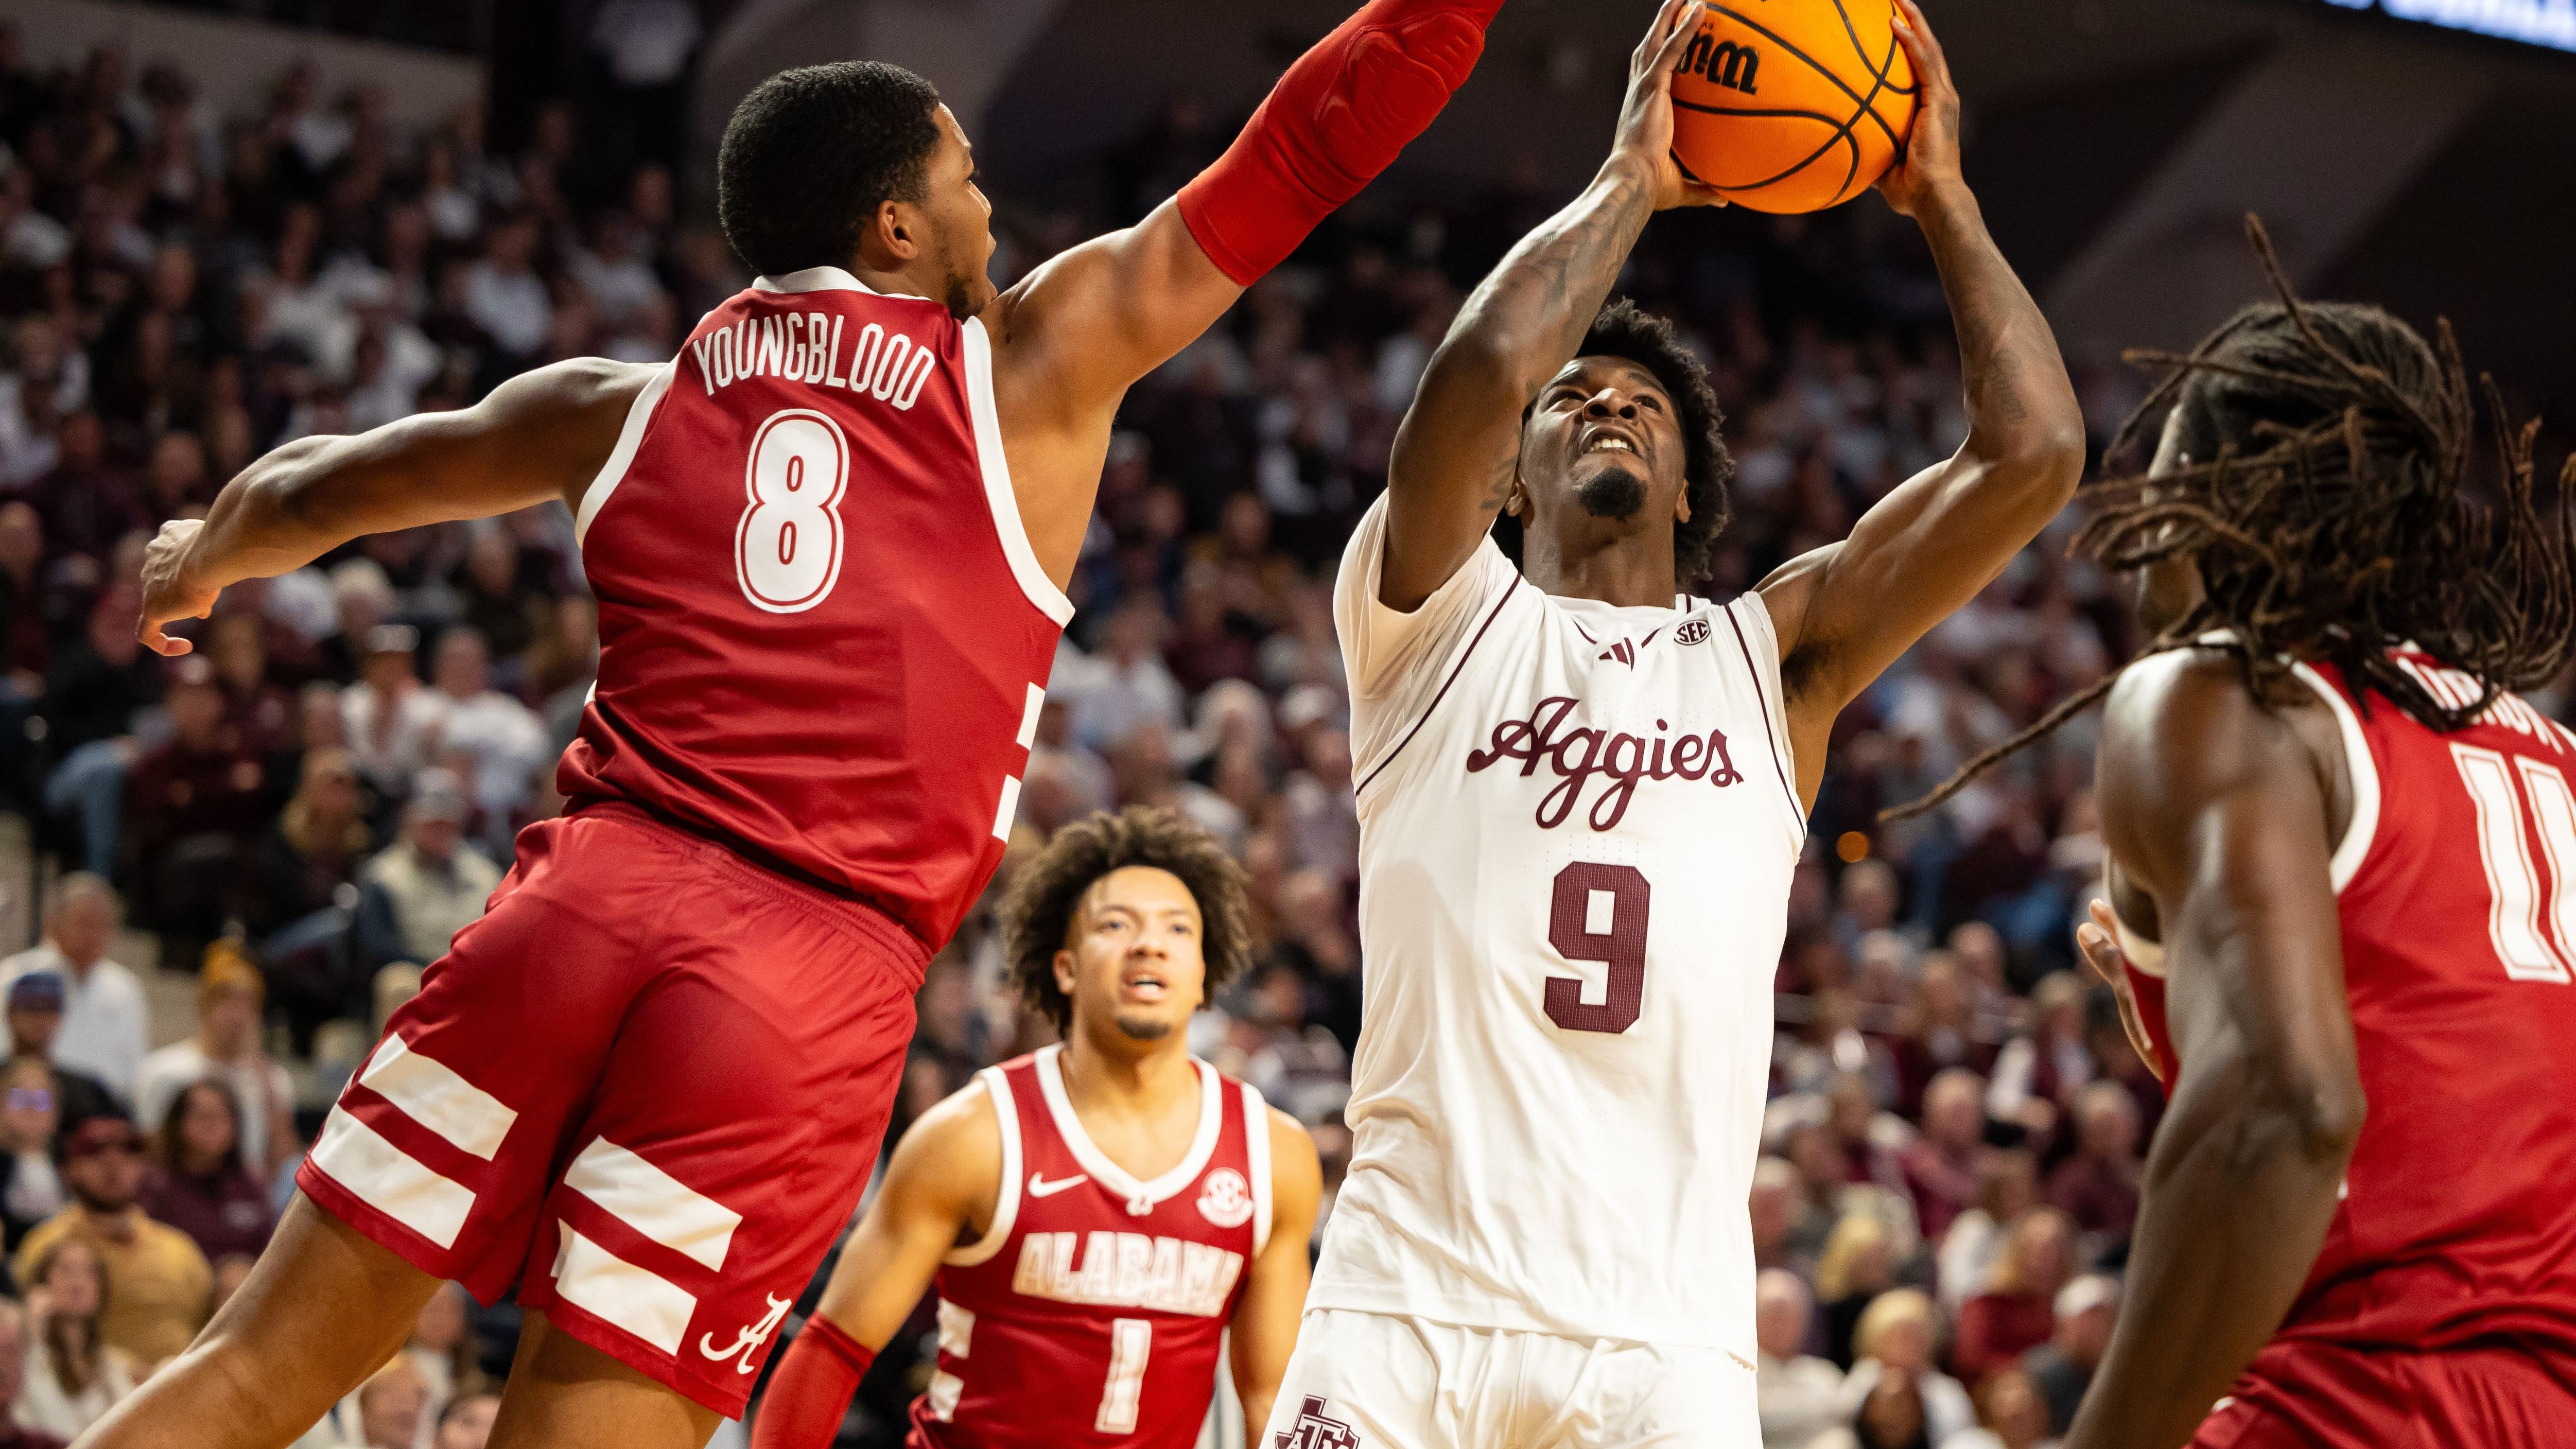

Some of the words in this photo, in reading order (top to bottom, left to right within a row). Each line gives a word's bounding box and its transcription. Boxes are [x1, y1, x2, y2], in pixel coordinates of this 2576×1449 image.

[1677, 31, 1760, 95] Wil
[693, 312, 935, 411] YOUNGBLOOD
[735, 409, 850, 614] 8
[1676, 621, 1708, 643] SEC
[1466, 696, 1744, 832] Aggies
[2449, 741, 2576, 984] 11
[1543, 861, 1651, 1034] 9
[1094, 1318, 1152, 1435] 1
